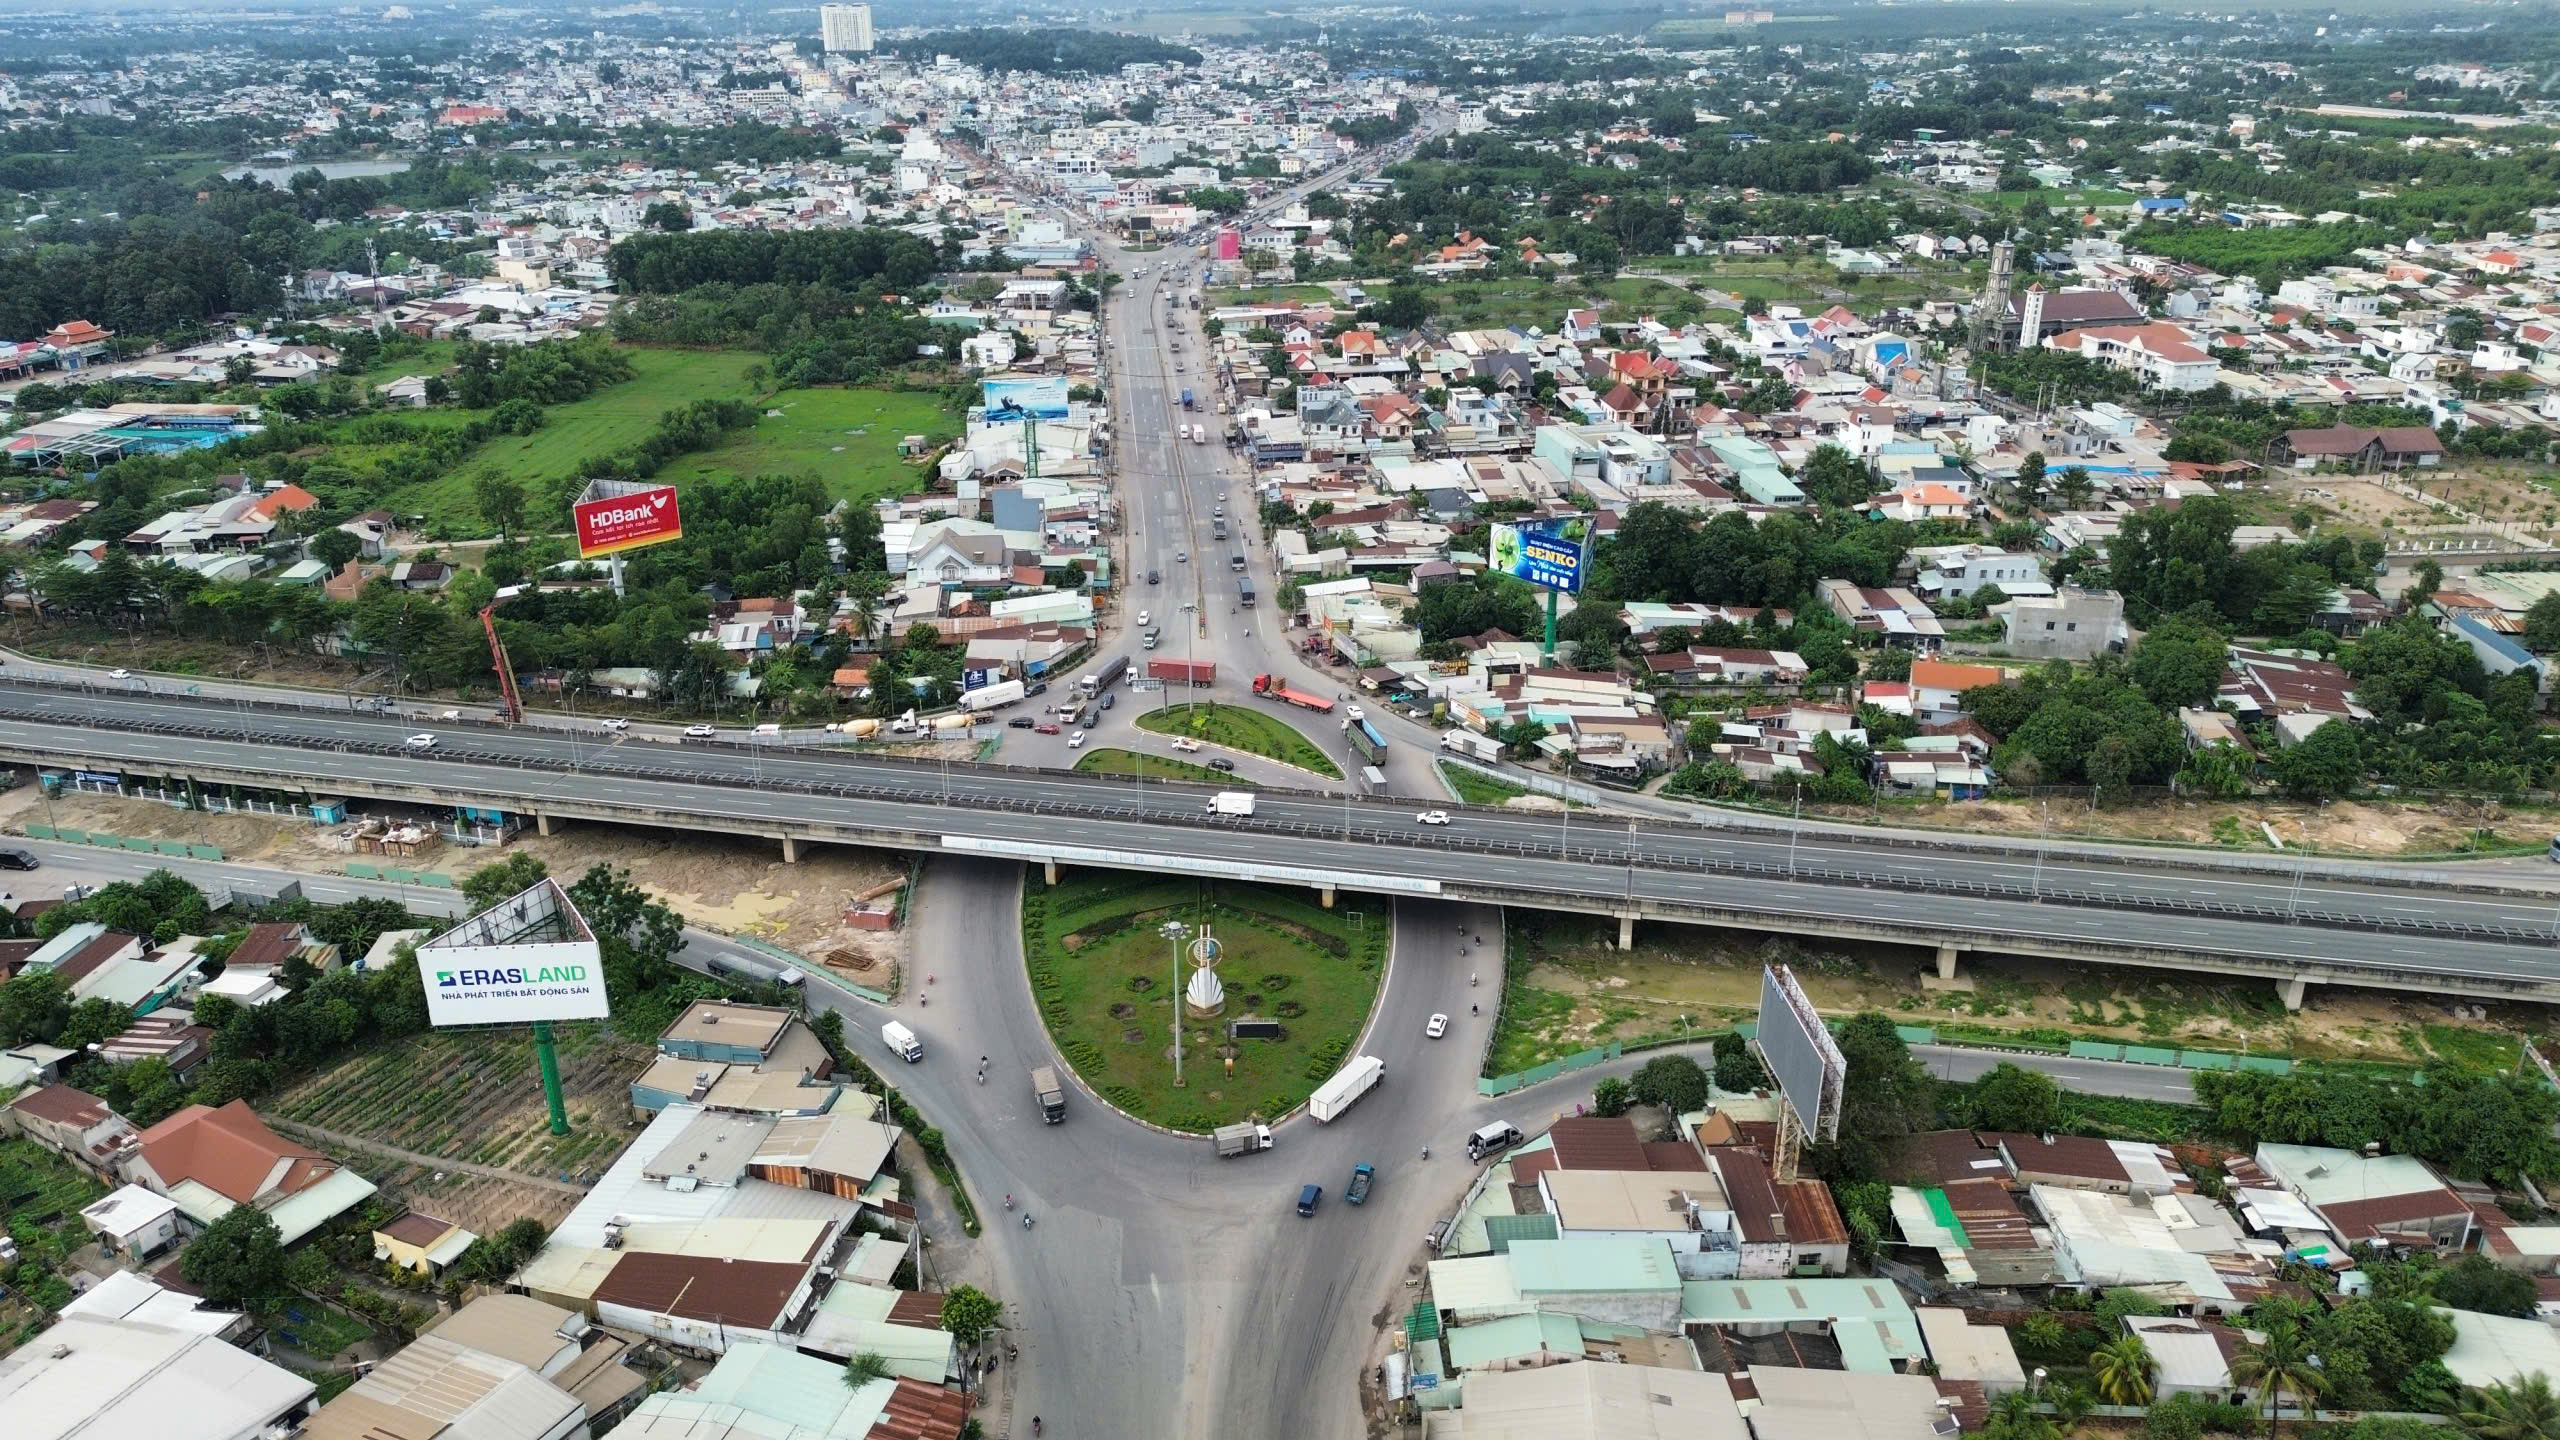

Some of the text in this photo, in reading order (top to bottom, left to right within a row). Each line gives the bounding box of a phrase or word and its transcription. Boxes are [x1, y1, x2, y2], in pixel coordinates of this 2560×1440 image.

[590, 504, 653, 529] HDBank
[1526, 545, 1577, 568] SENKO
[460, 965, 587, 986] ERASLAND
[441, 984, 590, 1000] NHÀ PHÁT TRIỂN BẤT ĐỘNG SẢN
